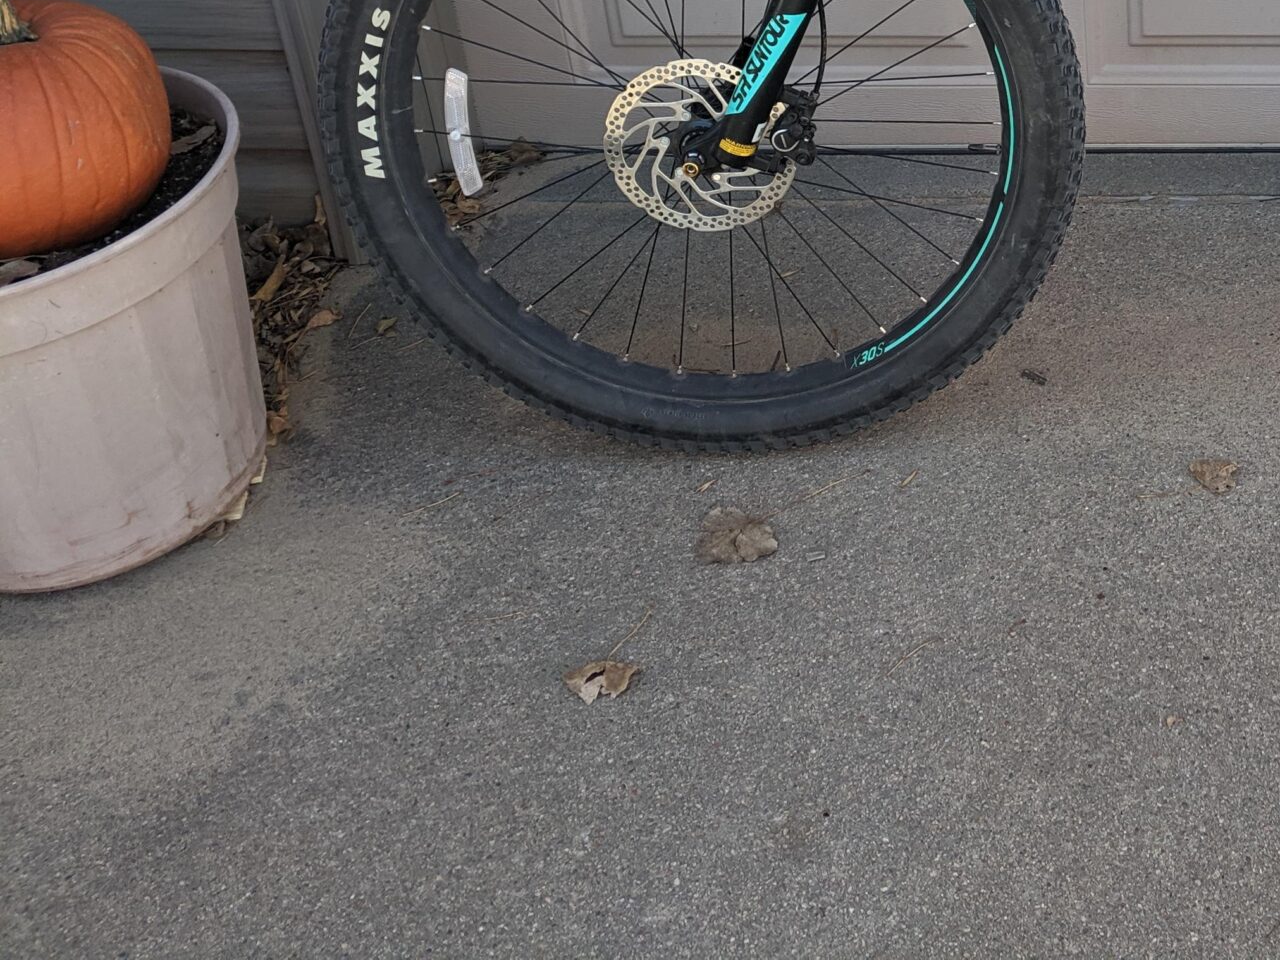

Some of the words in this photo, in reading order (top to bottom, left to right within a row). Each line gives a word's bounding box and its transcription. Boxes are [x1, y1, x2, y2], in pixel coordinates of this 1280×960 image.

[746, 14, 790, 83] SUNTOUR
[356, 7, 391, 179] MAXXIS
[850, 342, 885, 370] X30S
